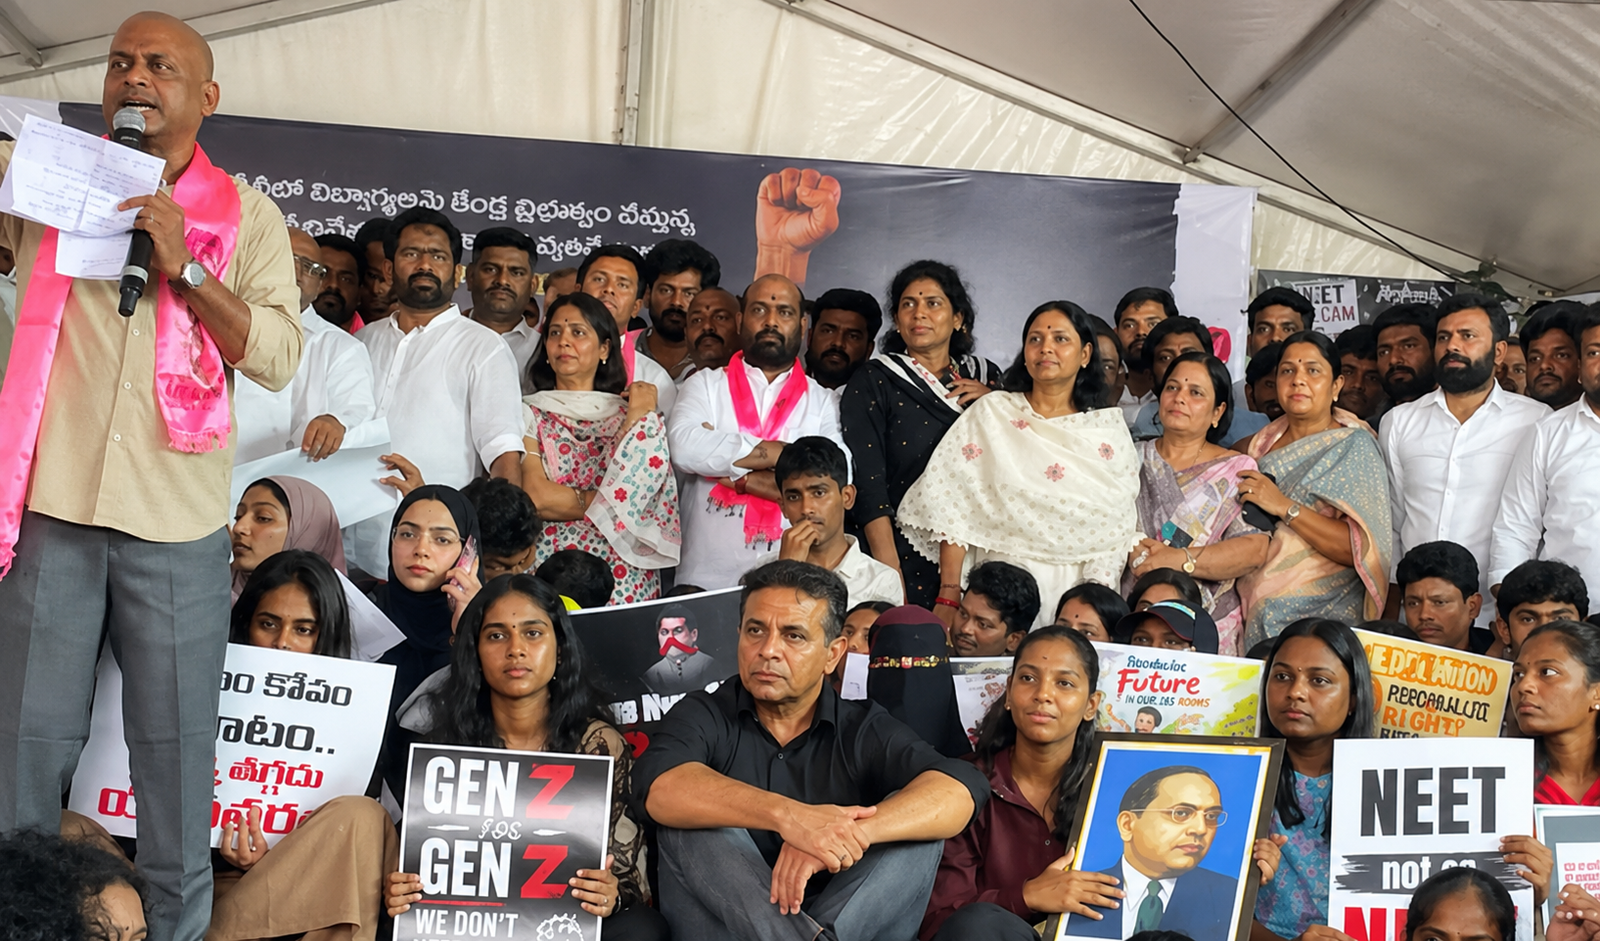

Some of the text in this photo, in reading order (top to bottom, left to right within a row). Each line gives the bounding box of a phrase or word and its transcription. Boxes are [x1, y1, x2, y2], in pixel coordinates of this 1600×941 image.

[1314, 305, 1356, 323] CAM
[1117, 668, 1200, 696] Future
[1125, 694, 1136, 705] IN
[423, 756, 576, 820] GEN Z
[1360, 766, 1506, 836] NEET
[419, 837, 569, 899] GEN Z
[1382, 856, 1432, 890] not
[415, 908, 449, 936] WE
